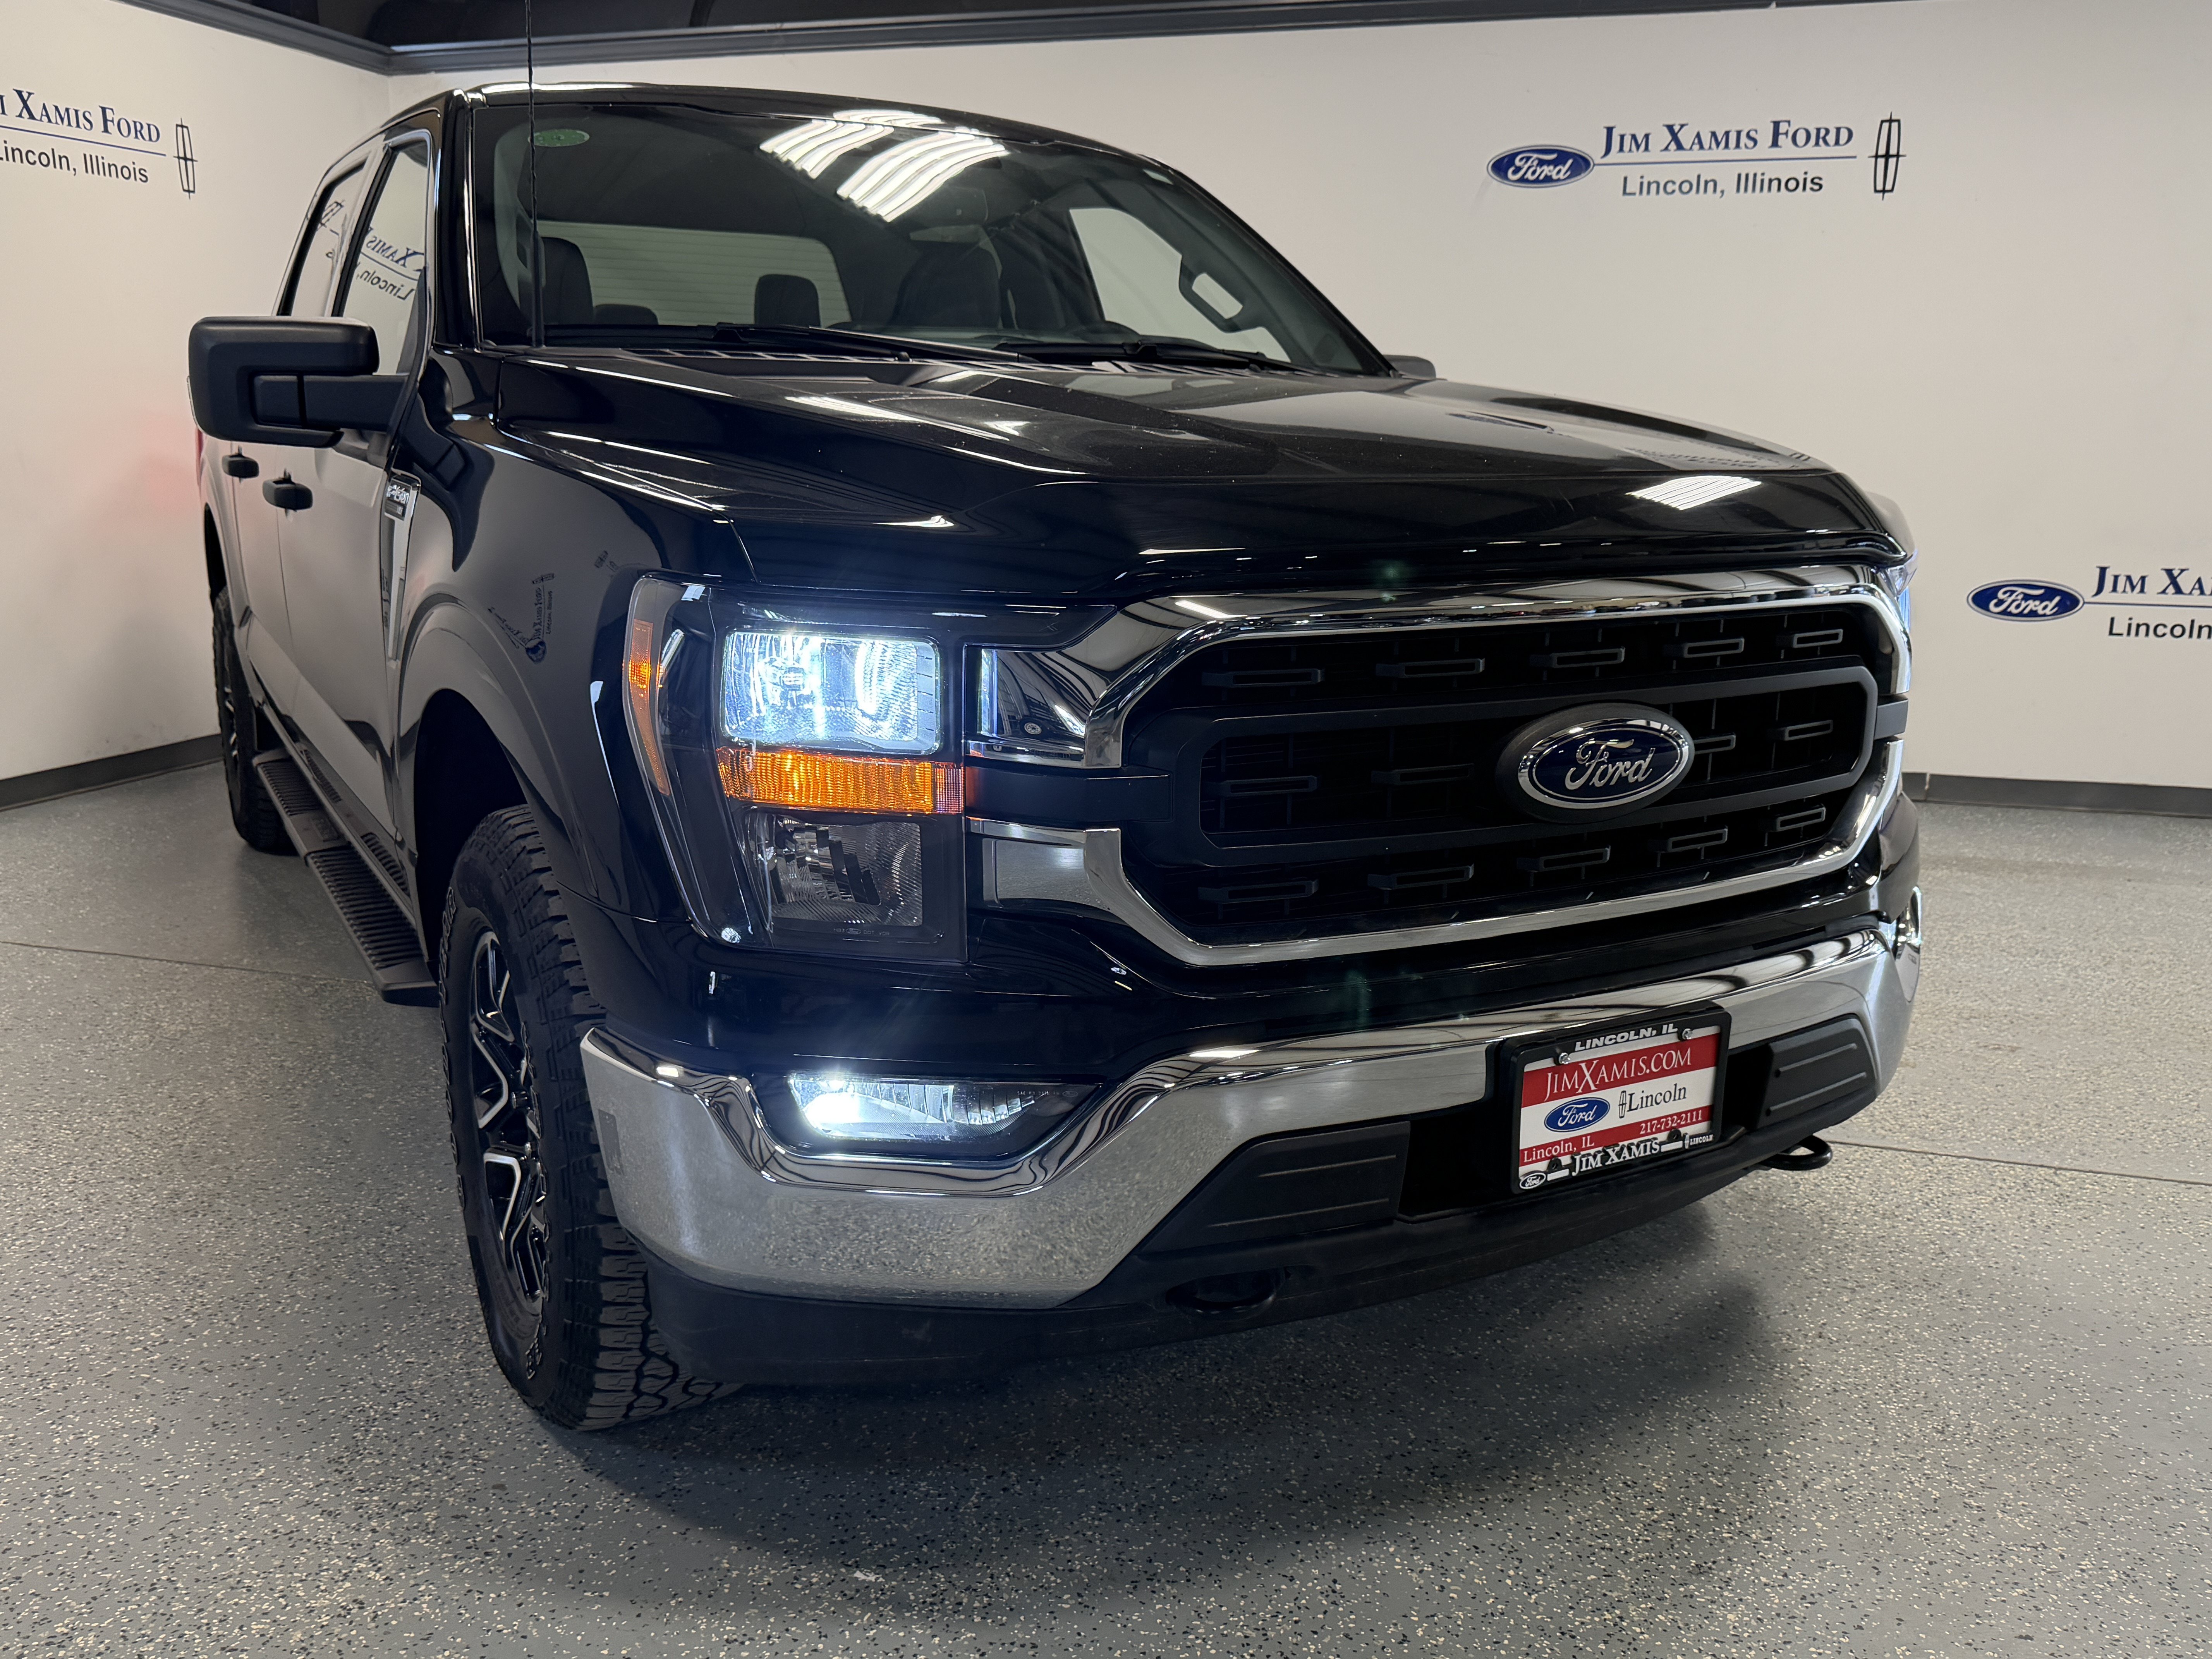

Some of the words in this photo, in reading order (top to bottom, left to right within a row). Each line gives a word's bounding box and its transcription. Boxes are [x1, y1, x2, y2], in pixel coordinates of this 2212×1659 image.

[13, 88, 93, 131] XAMIS
[99, 105, 160, 143] FORD
[1600, 125, 1652, 159] JIM
[1660, 123, 1758, 151] XAMIS
[1768, 120, 1854, 149] FORD
[0, 140, 77, 176] incoln,
[83, 153, 149, 183] Illinois
[1508, 153, 1573, 181] Ford
[1622, 173, 1725, 199] Lincoln,
[1735, 170, 1824, 194] Illinois
[2091, 565, 2149, 598] JIM
[2156, 568, 2212, 597] XA
[1989, 586, 2061, 615] Ford
[1565, 738, 1656, 790] Ford
[1575, 1026, 1657, 1052] LINCOLN,
[1661, 1024, 1679, 1034] IL
[1544, 1047, 1692, 1102] JIMXAMIS.COM
[1626, 1083, 1687, 1112] Lincoln
[1558, 1103, 1596, 1127] Ford
[1524, 1140, 1577, 1163] Lincoln,
[1582, 1136, 1594, 1149] IL
[1640, 1109, 1703, 1134] 217-732-2111
[1572, 1154, 1603, 1176] JIM
[1604, 1139, 1661, 1166] XAMIS
[1525, 1176, 1540, 1187] Ford
